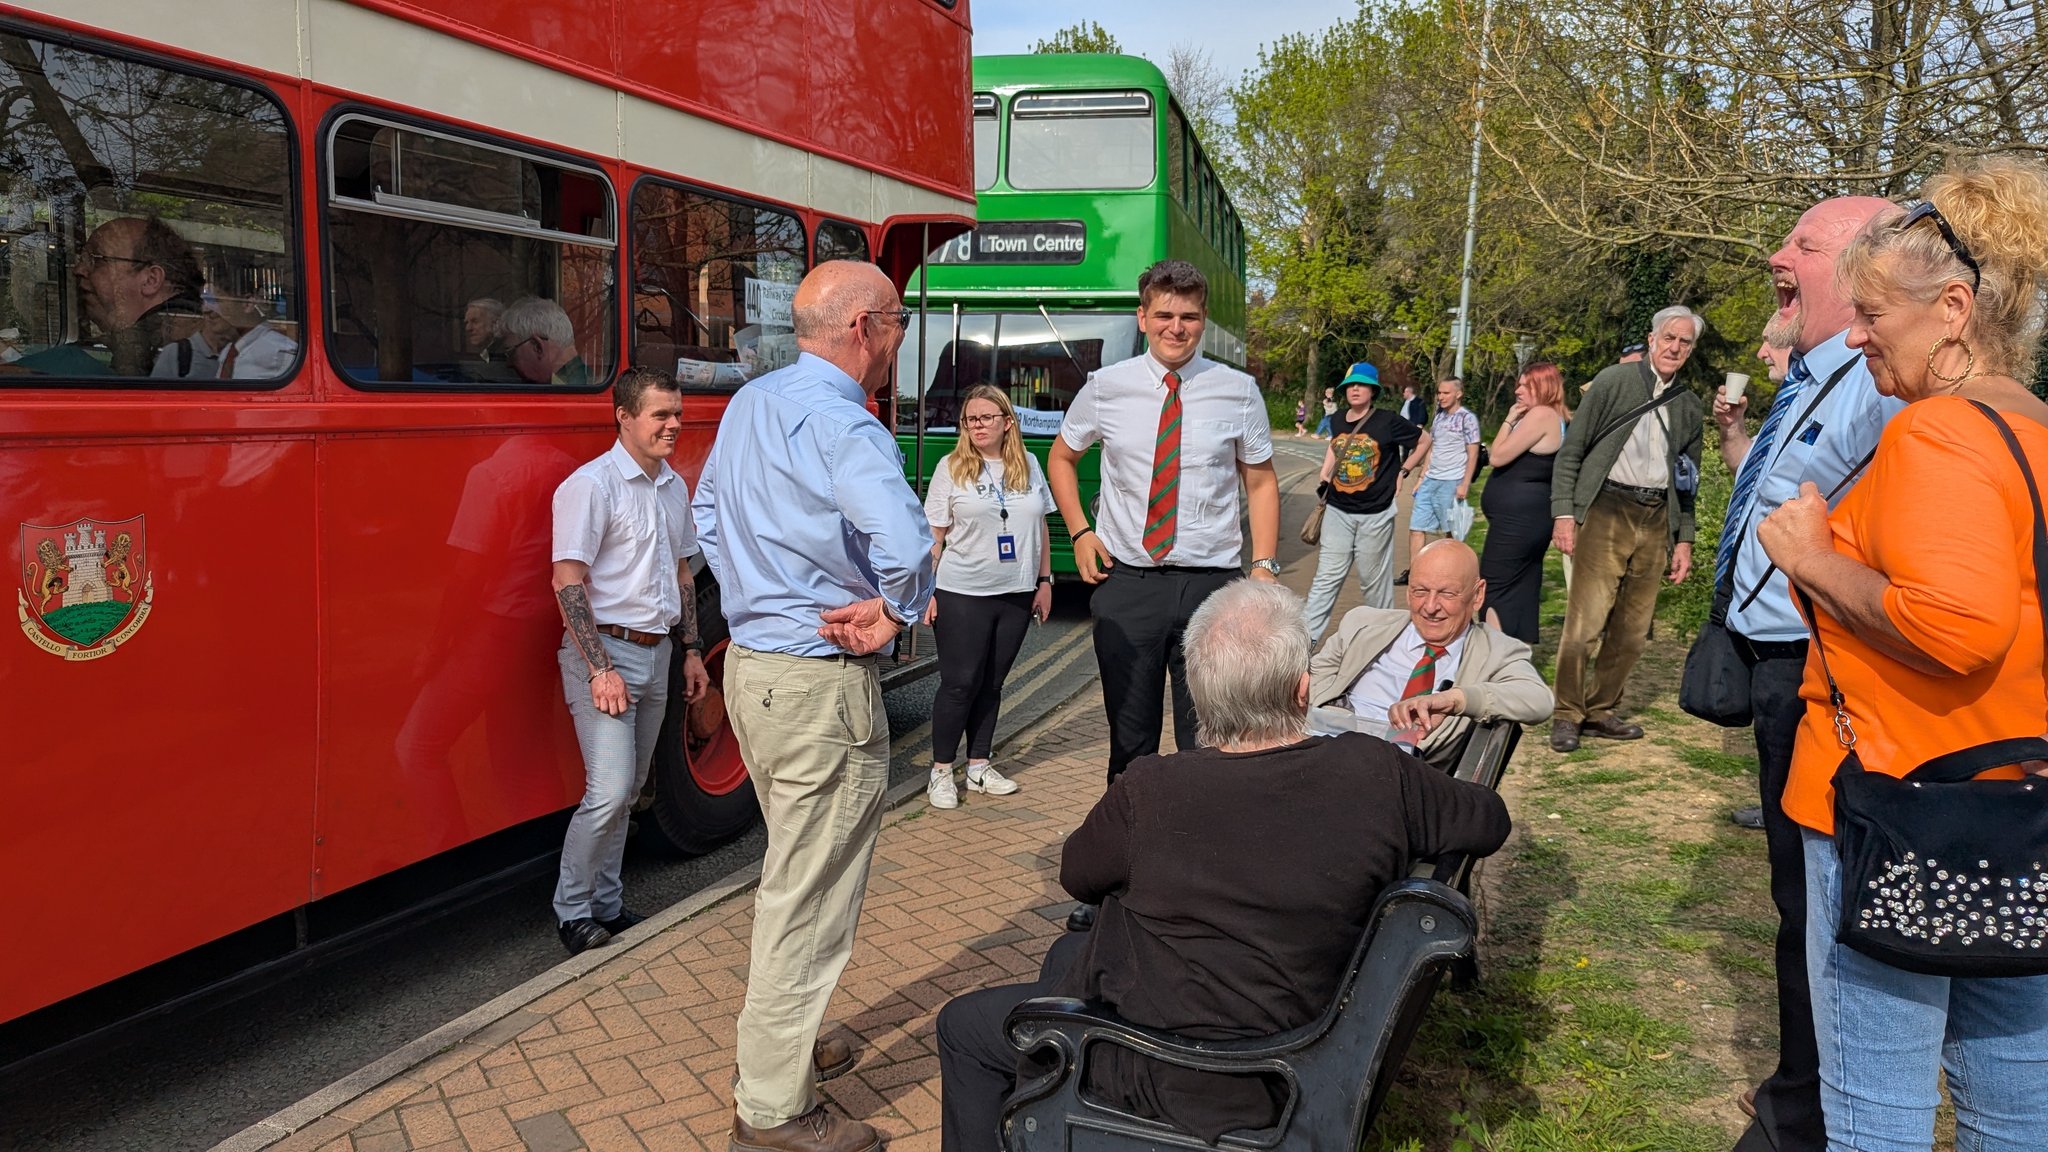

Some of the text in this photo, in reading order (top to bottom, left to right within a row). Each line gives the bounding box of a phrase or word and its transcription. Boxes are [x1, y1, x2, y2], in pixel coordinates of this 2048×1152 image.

[988, 234, 1084, 252] Town Centre
[747, 283, 762, 318] 440
[1023, 415, 1061, 431] Northampton
[27, 606, 149, 659] CASTELLO FORTIOR CONCORDIA
